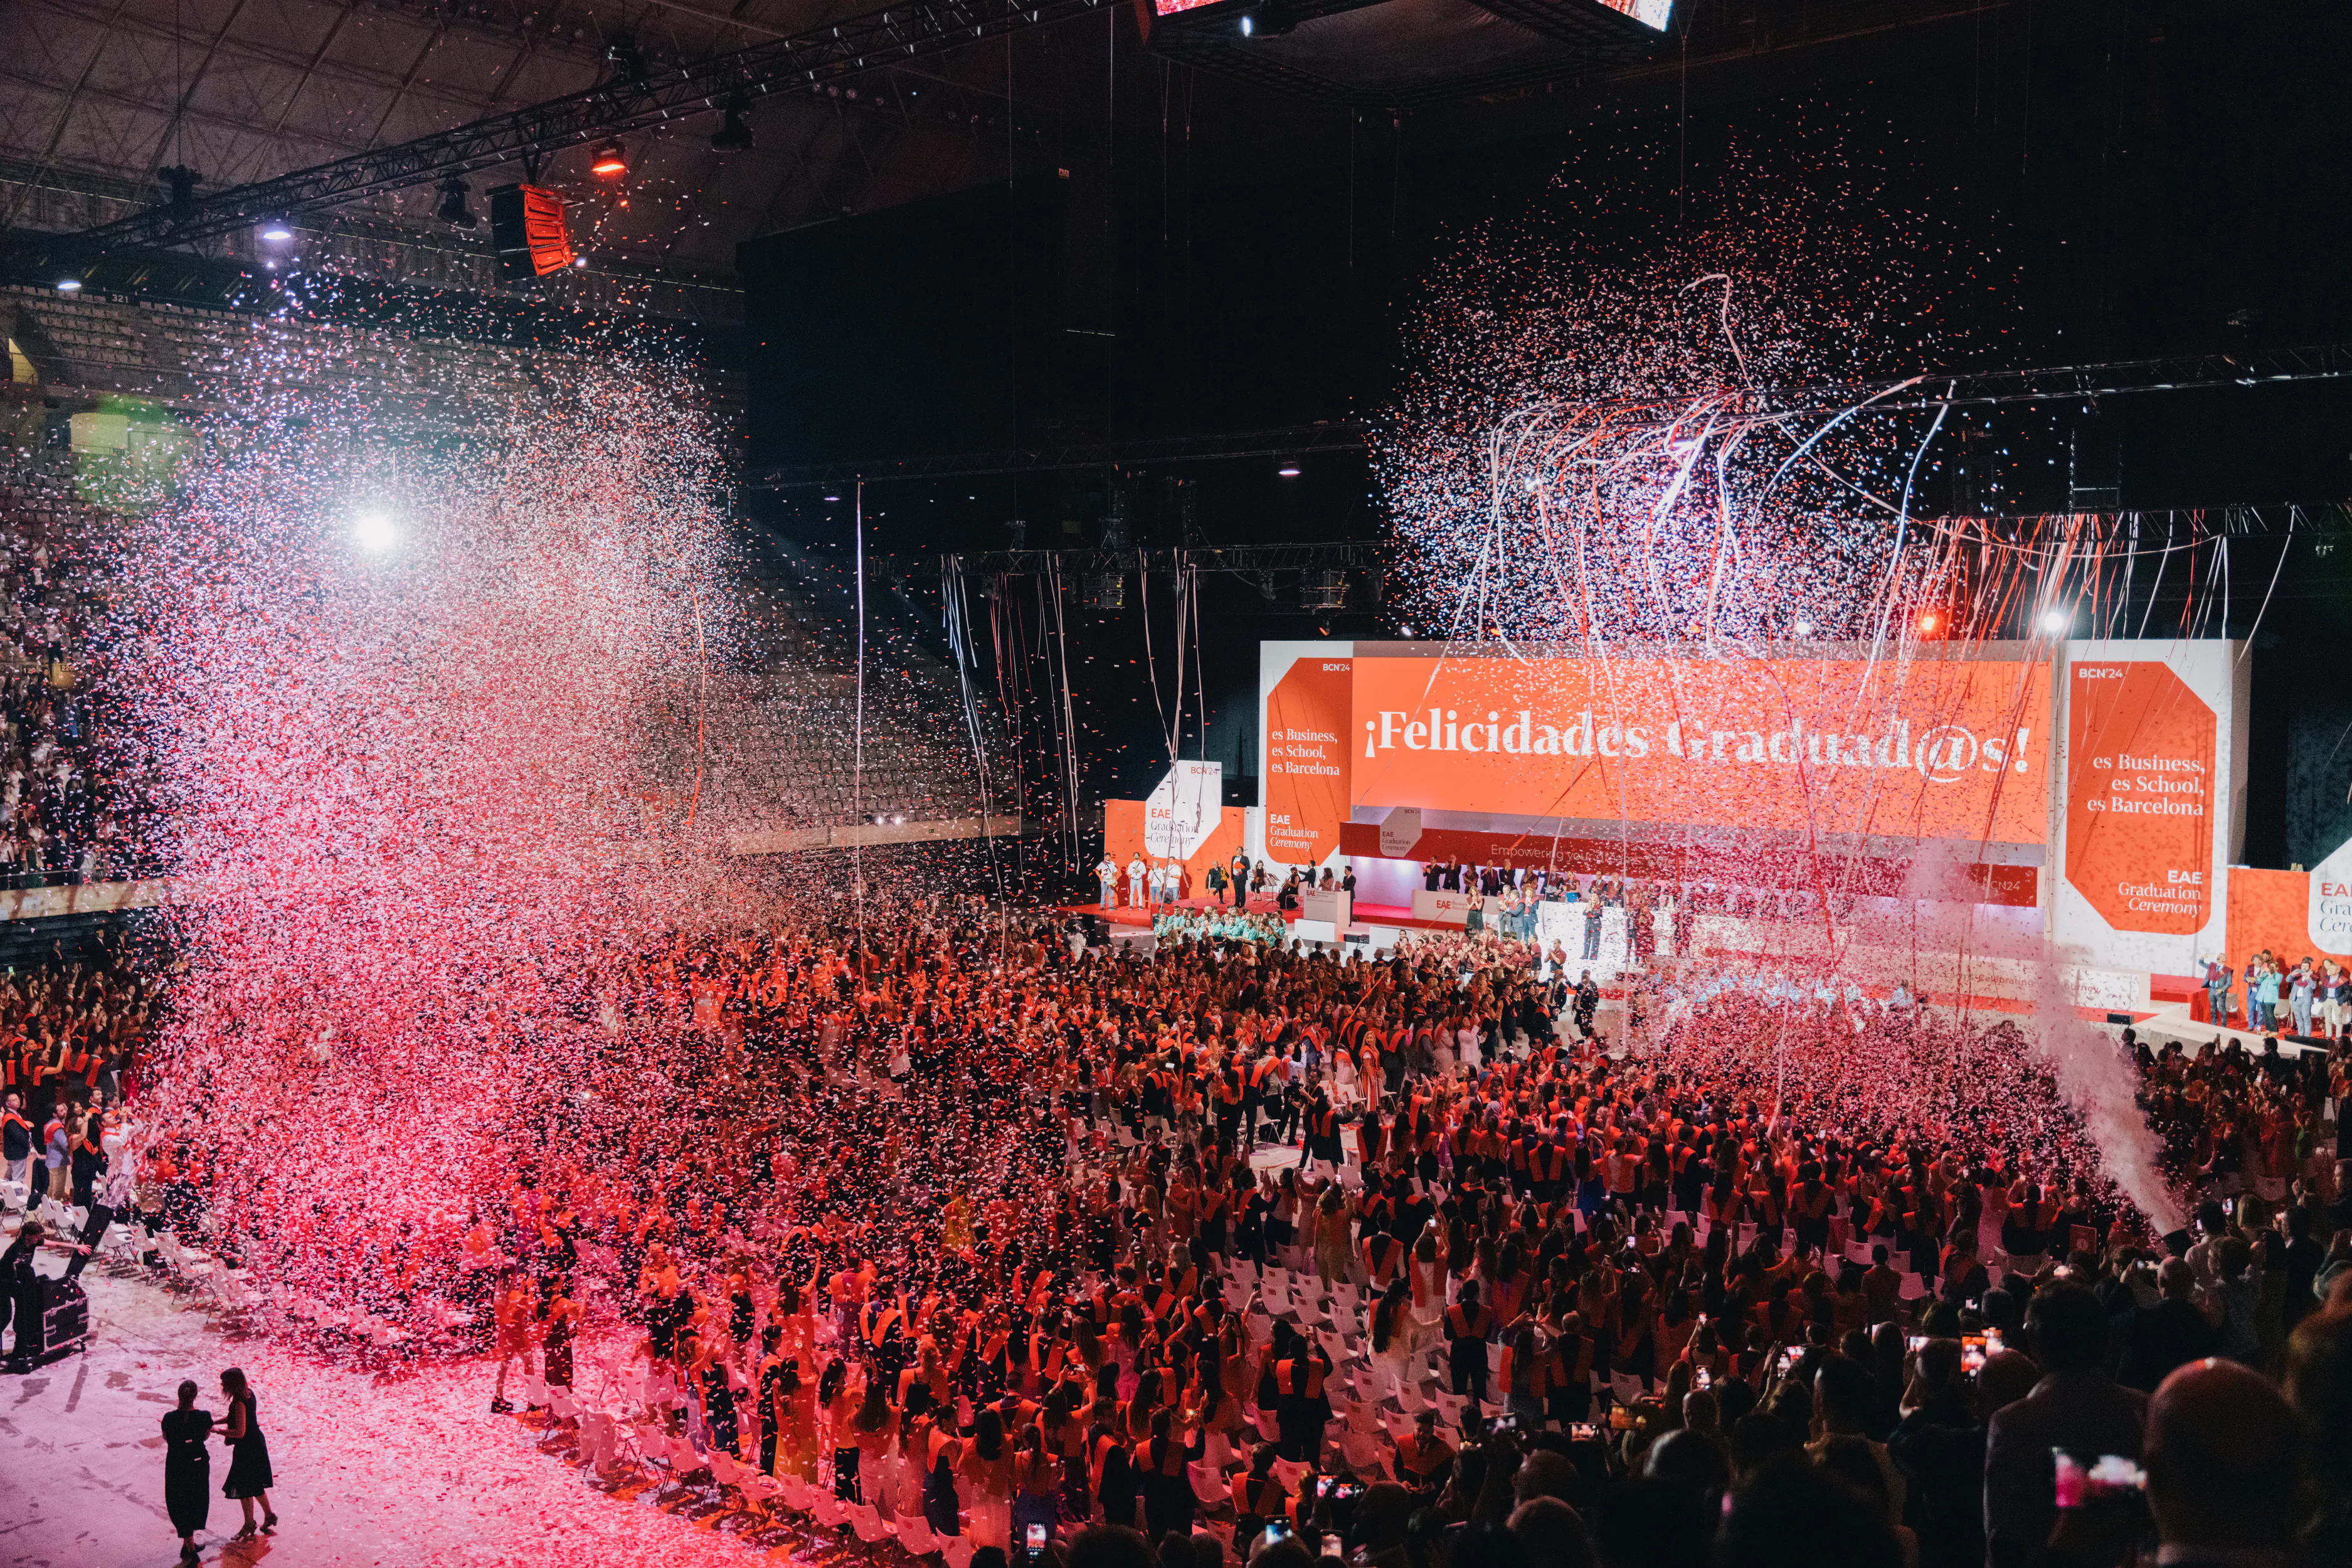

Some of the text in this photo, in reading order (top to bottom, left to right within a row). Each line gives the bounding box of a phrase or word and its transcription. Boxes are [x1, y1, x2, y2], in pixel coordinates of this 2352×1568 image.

[112, 294, 128, 304] 321
[1323, 663, 1350, 671] BCN'24
[2079, 668, 2123, 678] BCN'24
[1272, 728, 1337, 744] es Business,
[1271, 744, 1326, 761] es School,
[1365, 707, 2030, 783] ¡Felicidades Graduad@s!
[1271, 761, 1340, 776] es Barcelona
[2093, 753, 2205, 775] es Business,
[2112, 775, 2205, 797] es School,
[1151, 808, 1171, 818] EAE
[2087, 797, 2203, 815] es Barcelona
[1270, 813, 1290, 825] EAE
[1270, 825, 1318, 839] Graduation
[1270, 836, 1313, 852] Ceremony
[1491, 844, 1564, 862] Empowering
[2168, 870, 2203, 884] EAE
[2118, 882, 2201, 900] Graduation
[2321, 882, 2352, 898] EA
[1437, 900, 1451, 909] EAE
[2129, 898, 2202, 918] Ceremony
